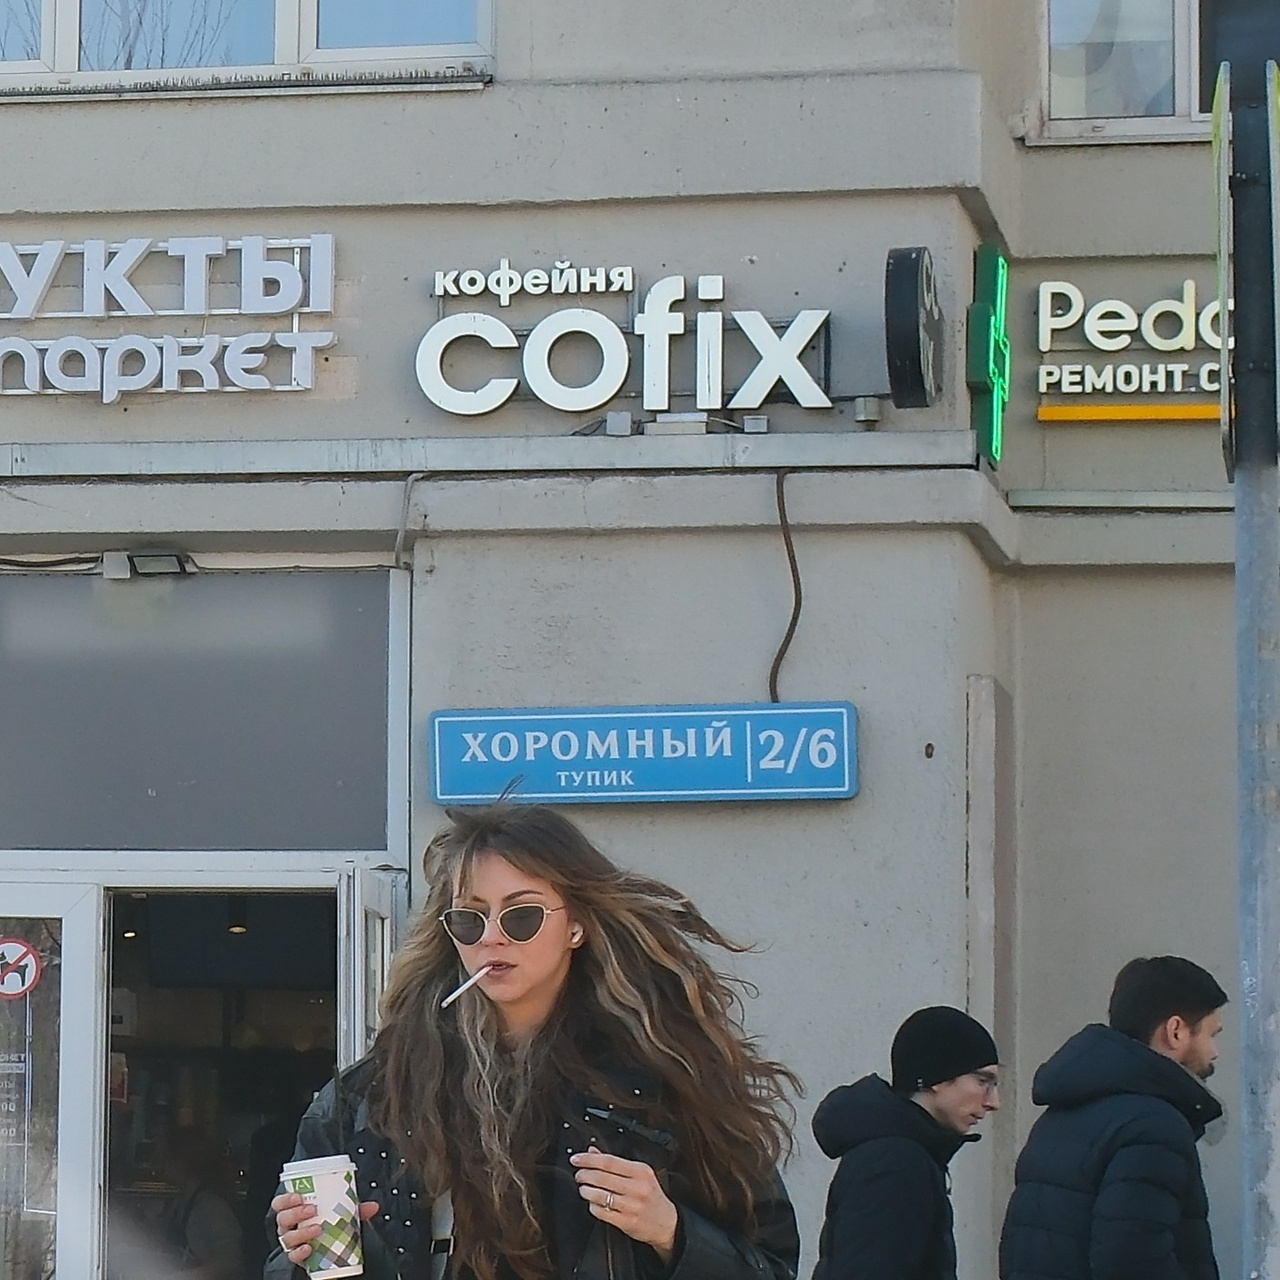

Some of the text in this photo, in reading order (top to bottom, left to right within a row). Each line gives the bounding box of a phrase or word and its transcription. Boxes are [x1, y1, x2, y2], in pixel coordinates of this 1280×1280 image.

[434, 258, 634, 307] кофейня
[415, 275, 833, 415] cofix
[1038, 363, 1190, 394] РЕМОНТ
[460, 719, 838, 774] ХОРОМНЫЙ 2/6
[555, 769, 635, 787] ТУПИК
